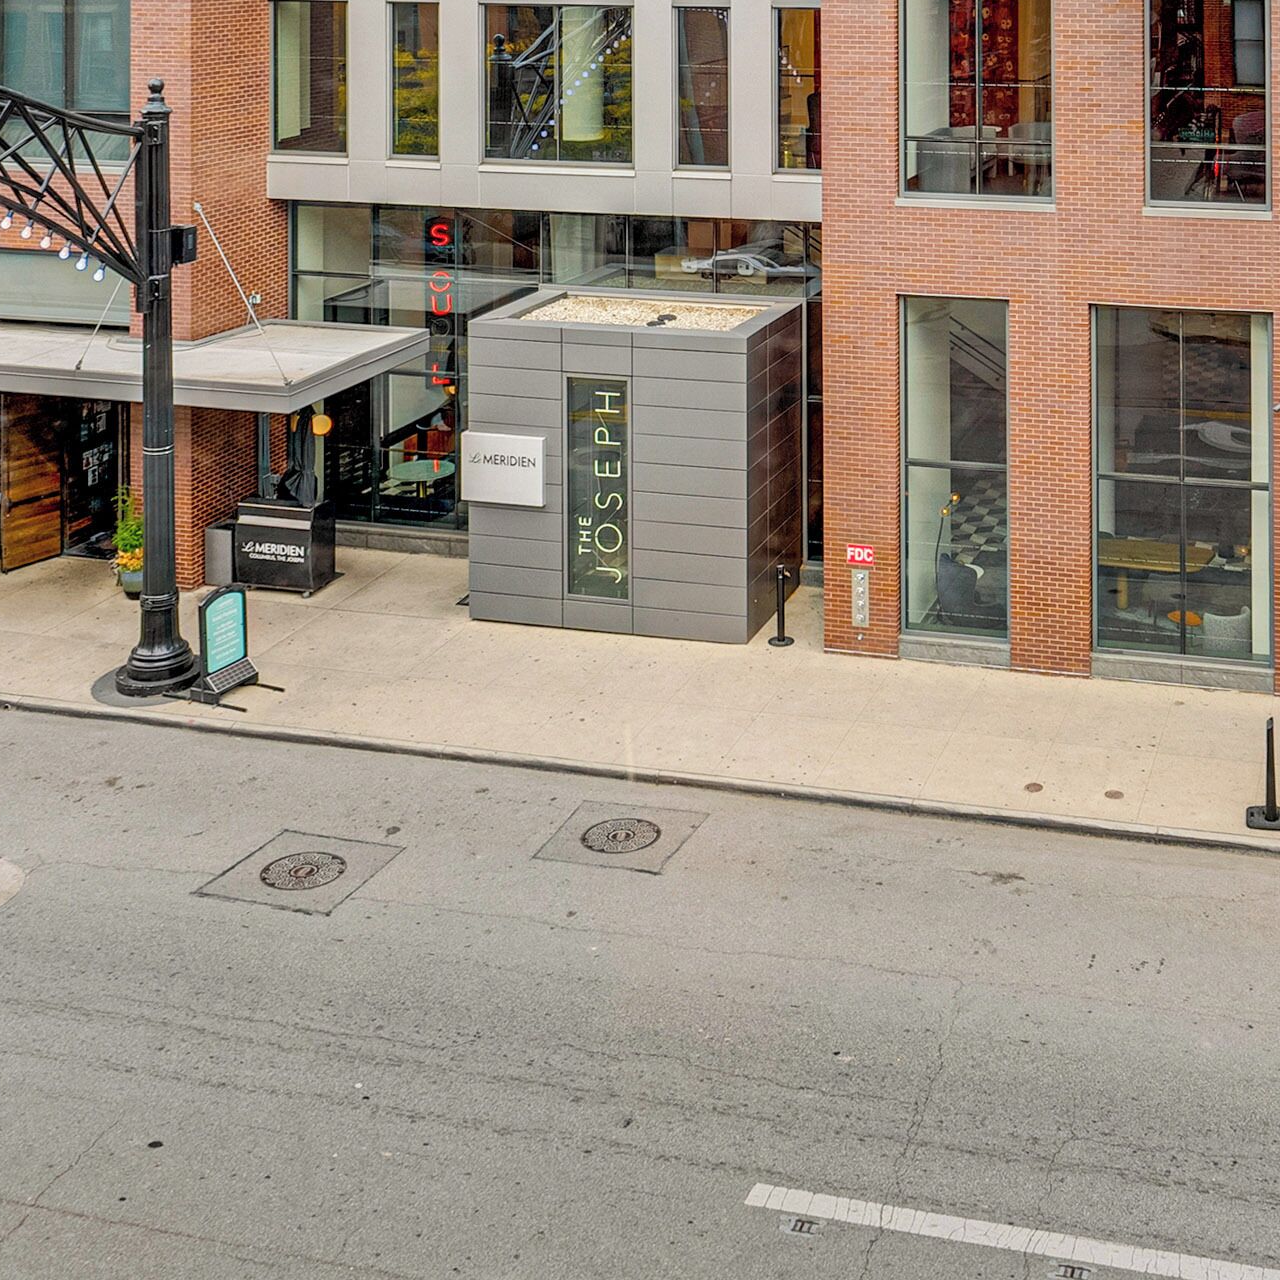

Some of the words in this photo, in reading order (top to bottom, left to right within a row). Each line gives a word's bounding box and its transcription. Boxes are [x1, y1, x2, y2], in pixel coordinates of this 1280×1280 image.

[468, 452, 482, 464] Le
[483, 454, 537, 468] MERIDIEN
[595, 391, 623, 584] JOSEPH
[578, 516, 592, 555] THE
[241, 541, 255, 553] Le
[255, 543, 305, 557] MERIDIEN
[847, 547, 874, 562] FDC
